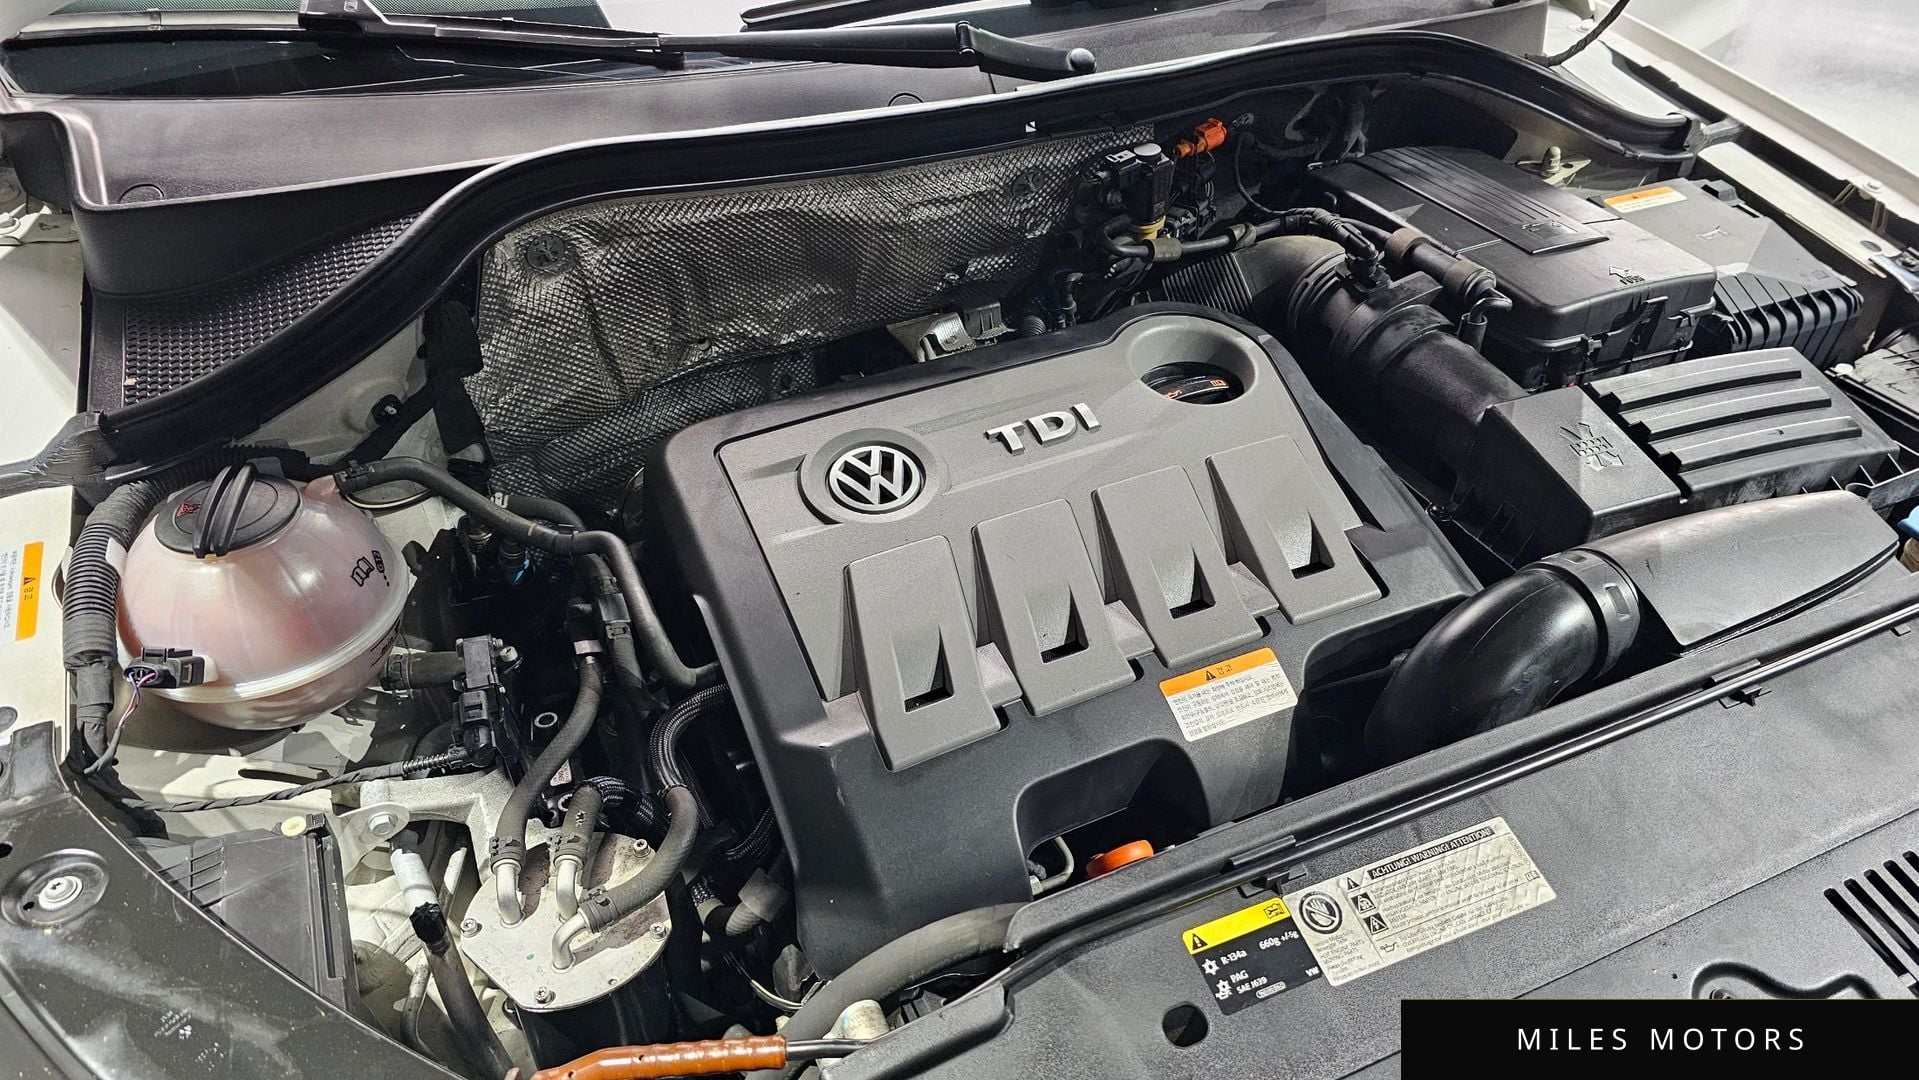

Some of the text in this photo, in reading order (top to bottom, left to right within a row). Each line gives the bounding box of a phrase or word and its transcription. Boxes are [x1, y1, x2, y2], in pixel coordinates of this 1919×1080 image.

[983, 403, 1100, 456] TDI
[1370, 857, 1413, 878] ACHTUNG!
[1410, 843, 1451, 863] WARNING!
[1448, 827, 1492, 849] ATTENTION!
[1220, 950, 1248, 966] R-134a
[1259, 937, 1282, 950] 660g
[1230, 969, 1249, 984] PAG
[1305, 966, 1320, 977] VW
[1236, 983, 1251, 995] SAE
